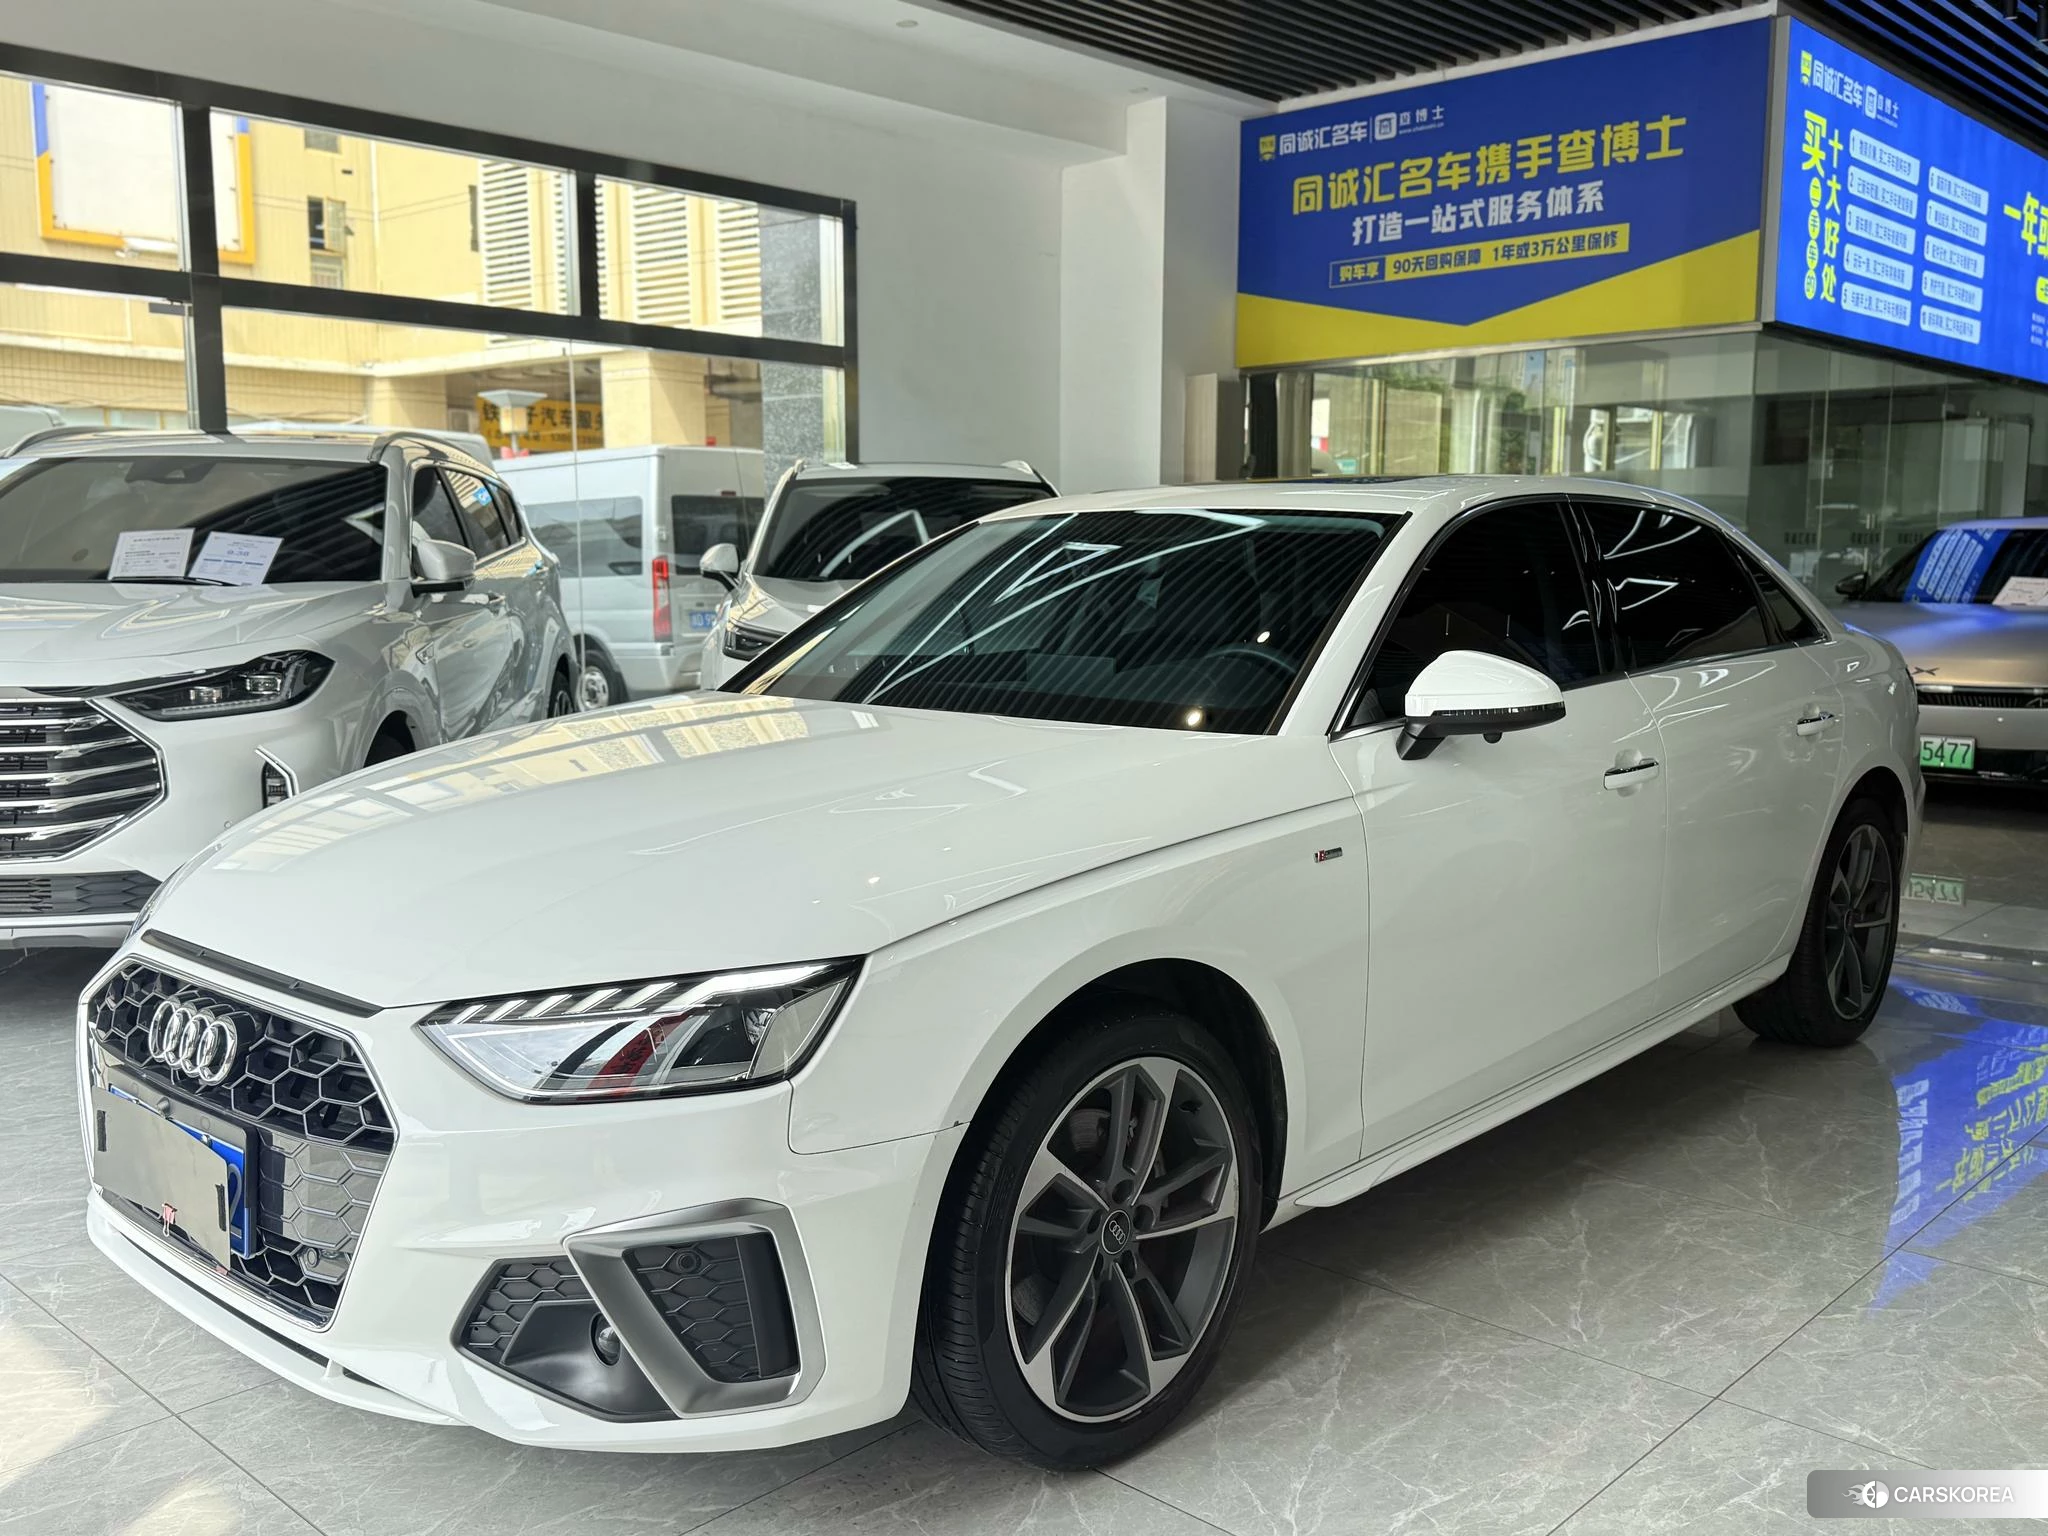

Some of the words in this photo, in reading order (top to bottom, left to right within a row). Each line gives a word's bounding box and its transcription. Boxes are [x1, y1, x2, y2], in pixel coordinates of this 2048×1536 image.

[1813, 59, 1864, 109] 同诚汇名车
[1279, 120, 1368, 156] 同诚汇名车
[1399, 105, 1445, 126] 查博士
[1293, 115, 1687, 215] 同诚汇名车携手查博士
[1352, 180, 1605, 246] 打造一站式服务体系
[1820, 128, 1844, 303] 十大好处
[1339, 260, 1379, 282] 购车享
[1392, 248, 1481, 274] 90天回购保障
[1493, 231, 1619, 262] 1年或3万公里保修
[1922, 740, 1971, 764] 5477
